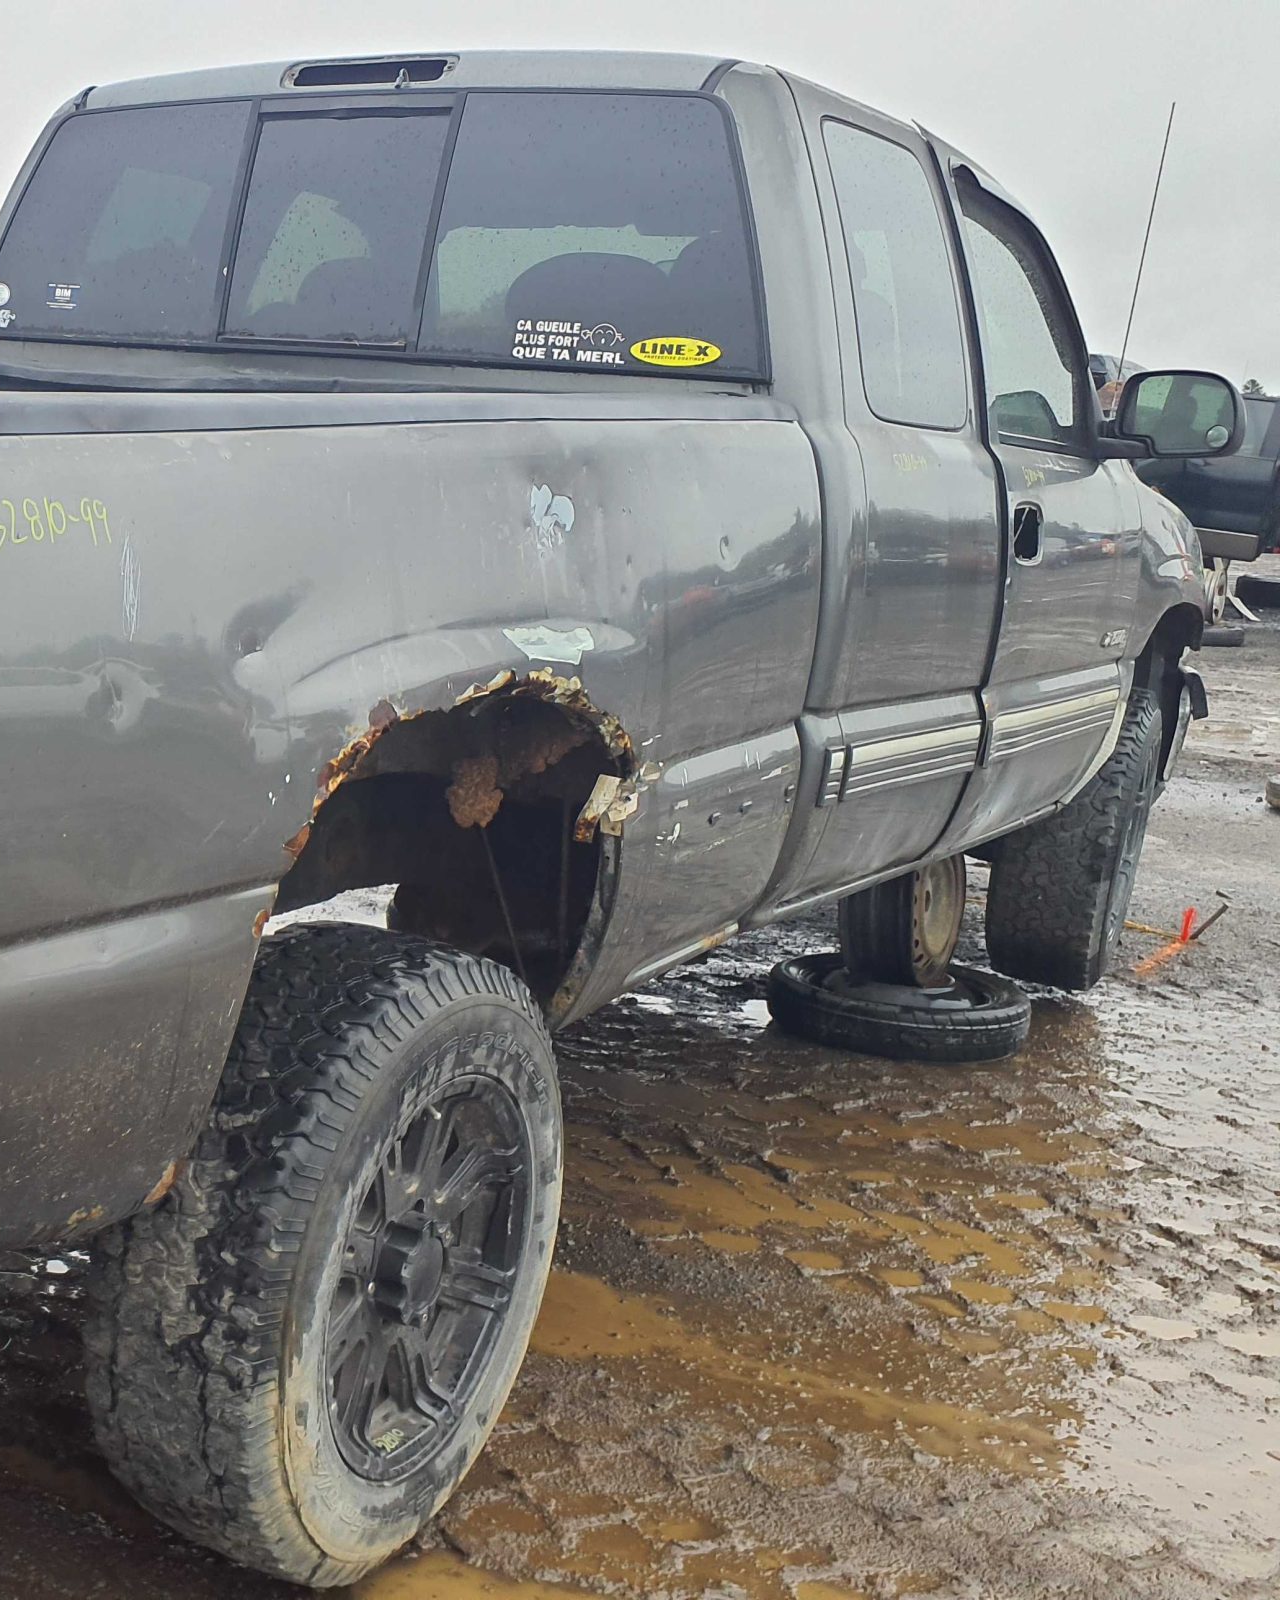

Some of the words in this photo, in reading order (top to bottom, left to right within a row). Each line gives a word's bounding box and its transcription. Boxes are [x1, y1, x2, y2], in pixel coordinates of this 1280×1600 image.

[516, 320, 532, 331] CA
[536, 320, 581, 334] GUEULE
[514, 333, 545, 346] PLUS
[547, 335, 579, 348] FORT
[512, 346, 547, 359] QUE
[552, 349, 570, 360] TA
[639, 342, 712, 357] LINE-X
